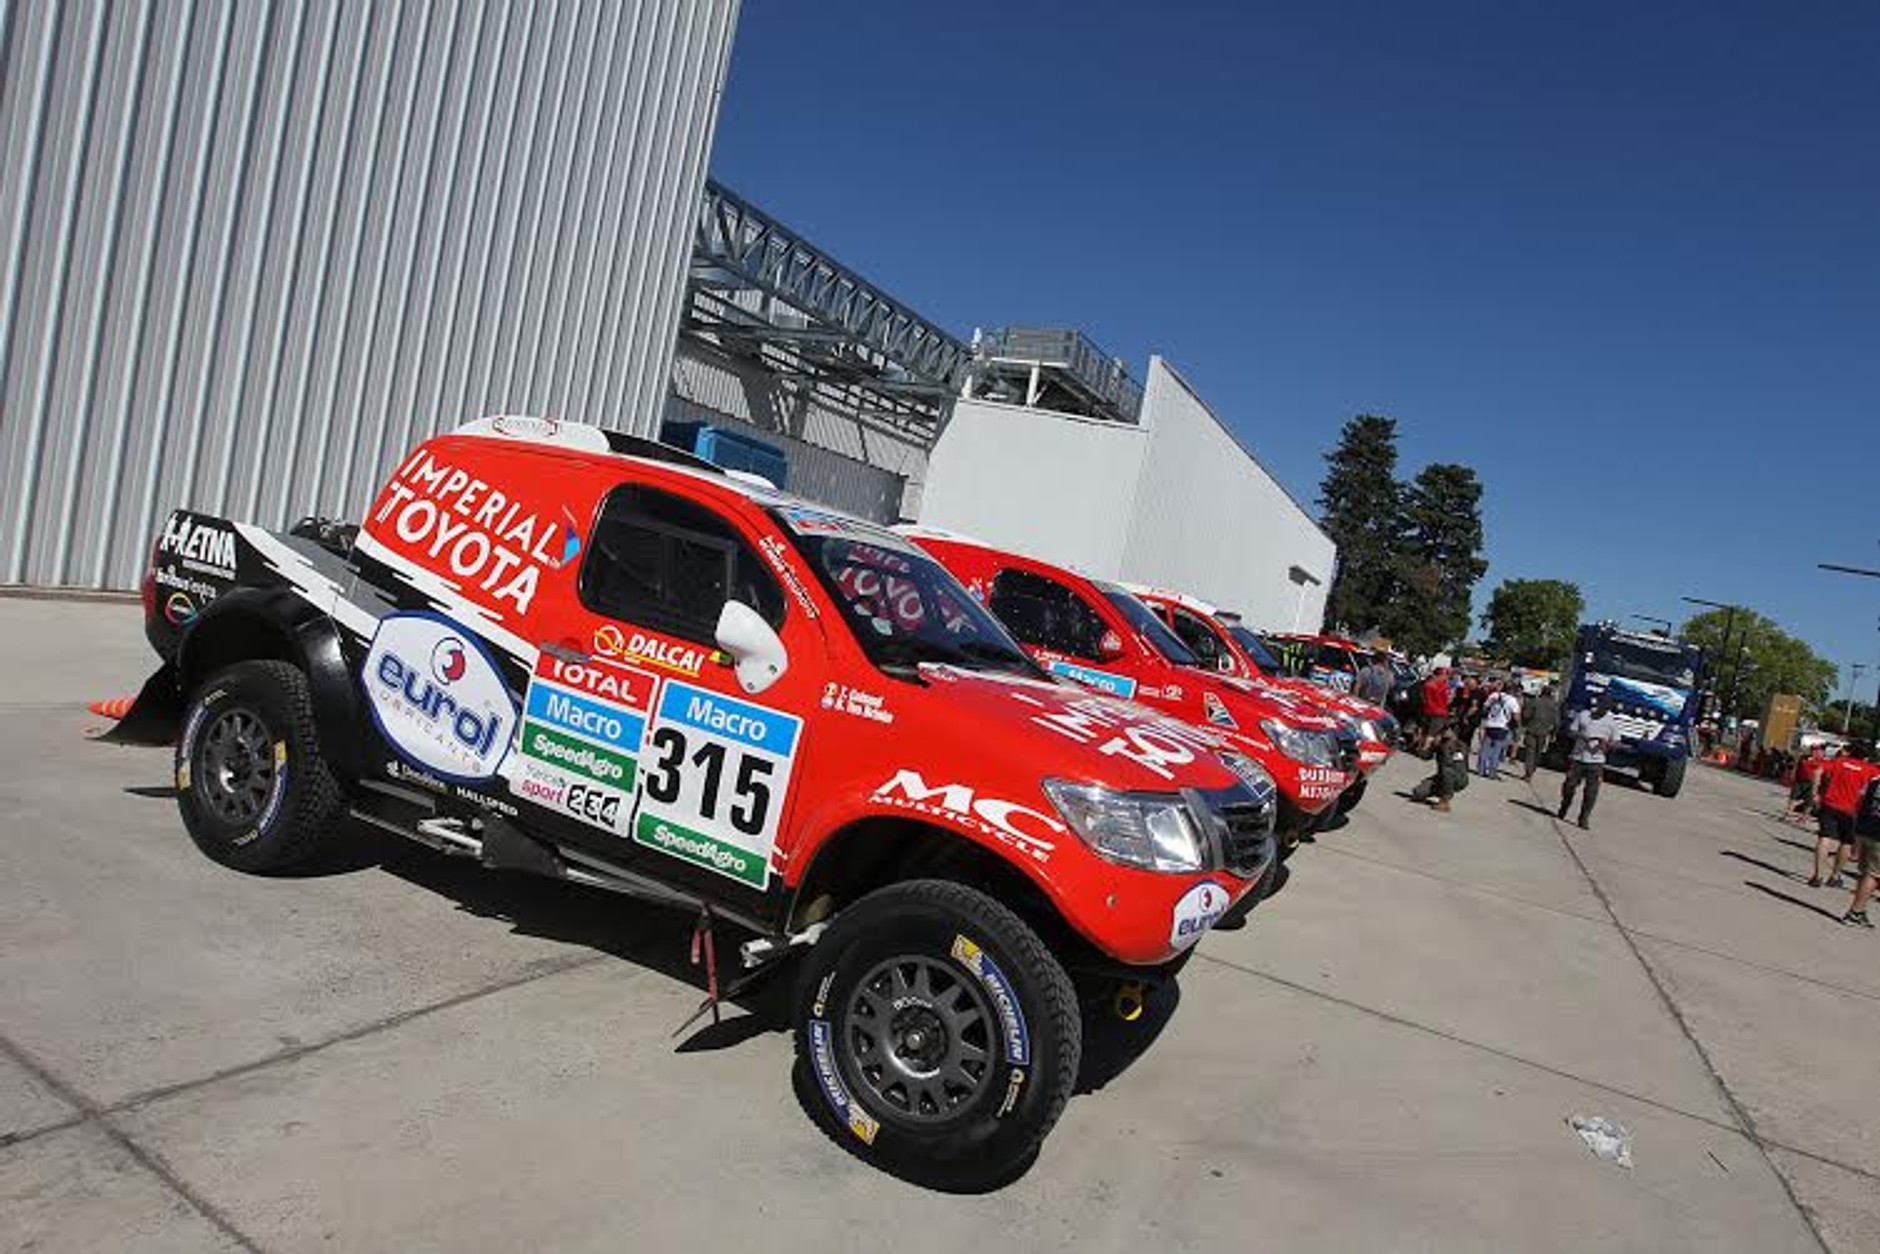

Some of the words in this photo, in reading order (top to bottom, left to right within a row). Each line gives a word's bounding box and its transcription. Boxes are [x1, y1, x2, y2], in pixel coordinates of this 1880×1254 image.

[400, 449, 558, 565] IMPERIAL
[374, 481, 540, 616] TOYOTA
[378, 653, 500, 758] eurol
[552, 659, 637, 703] TOTAL
[546, 694, 622, 740] Macro
[687, 696, 767, 741] Macro
[533, 733, 623, 779] SpeedAgro
[646, 726, 775, 837] 315
[869, 795, 1050, 863] MULTICYCLE
[874, 770, 1067, 852] MC
[653, 823, 747, 872] SpeedAgro
